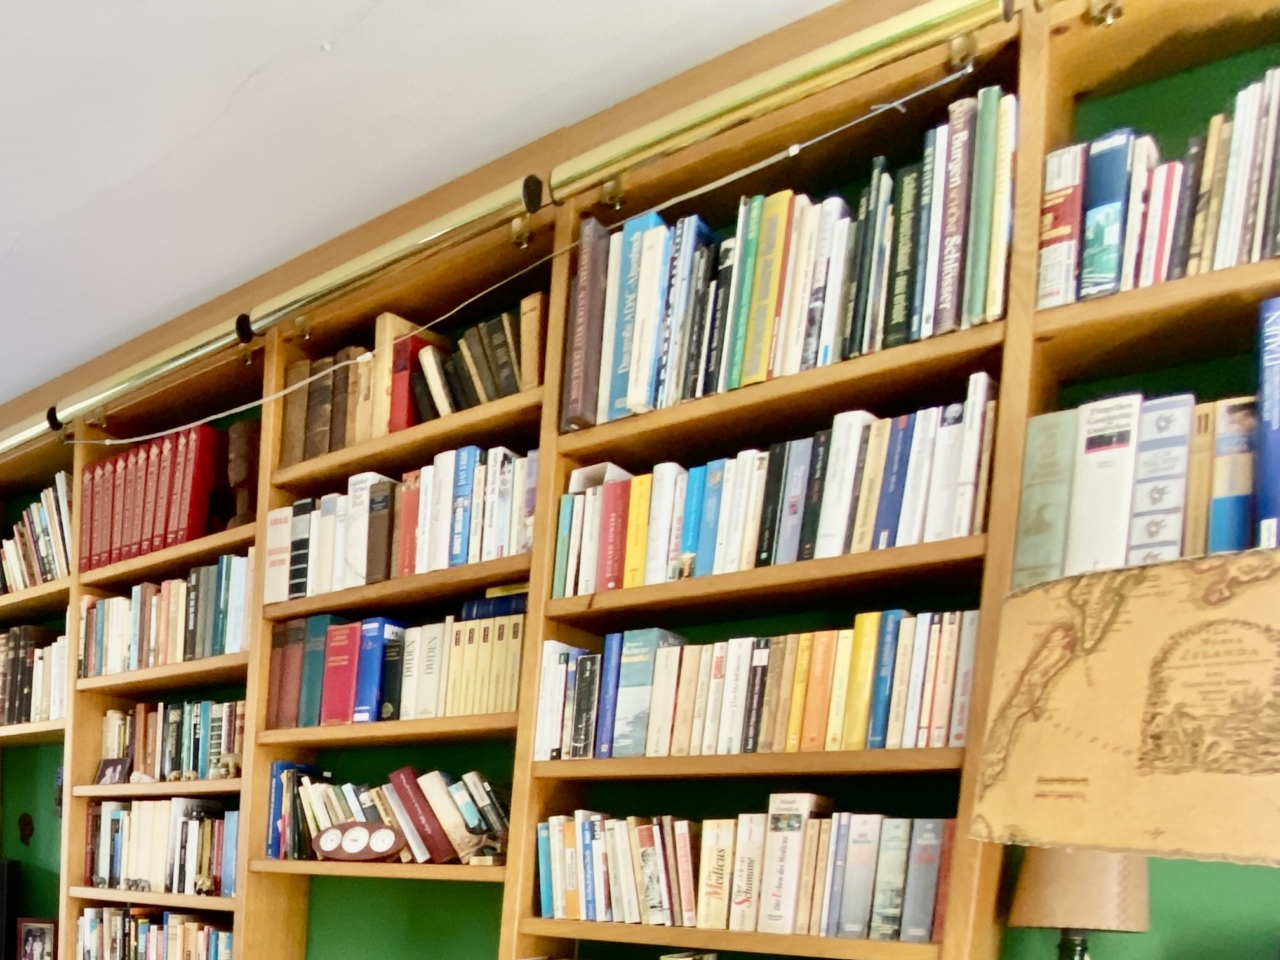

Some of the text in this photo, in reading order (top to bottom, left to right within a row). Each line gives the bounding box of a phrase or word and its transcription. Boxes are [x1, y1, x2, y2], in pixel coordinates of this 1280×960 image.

[949, 130, 968, 188] Burgen
[939, 234, 961, 310] Schlösser
[404, 640, 415, 678] DUDEN
[425, 636, 437, 675] DUDEN
[705, 848, 726, 901] Medicus
[733, 856, 756, 908] Schamane
